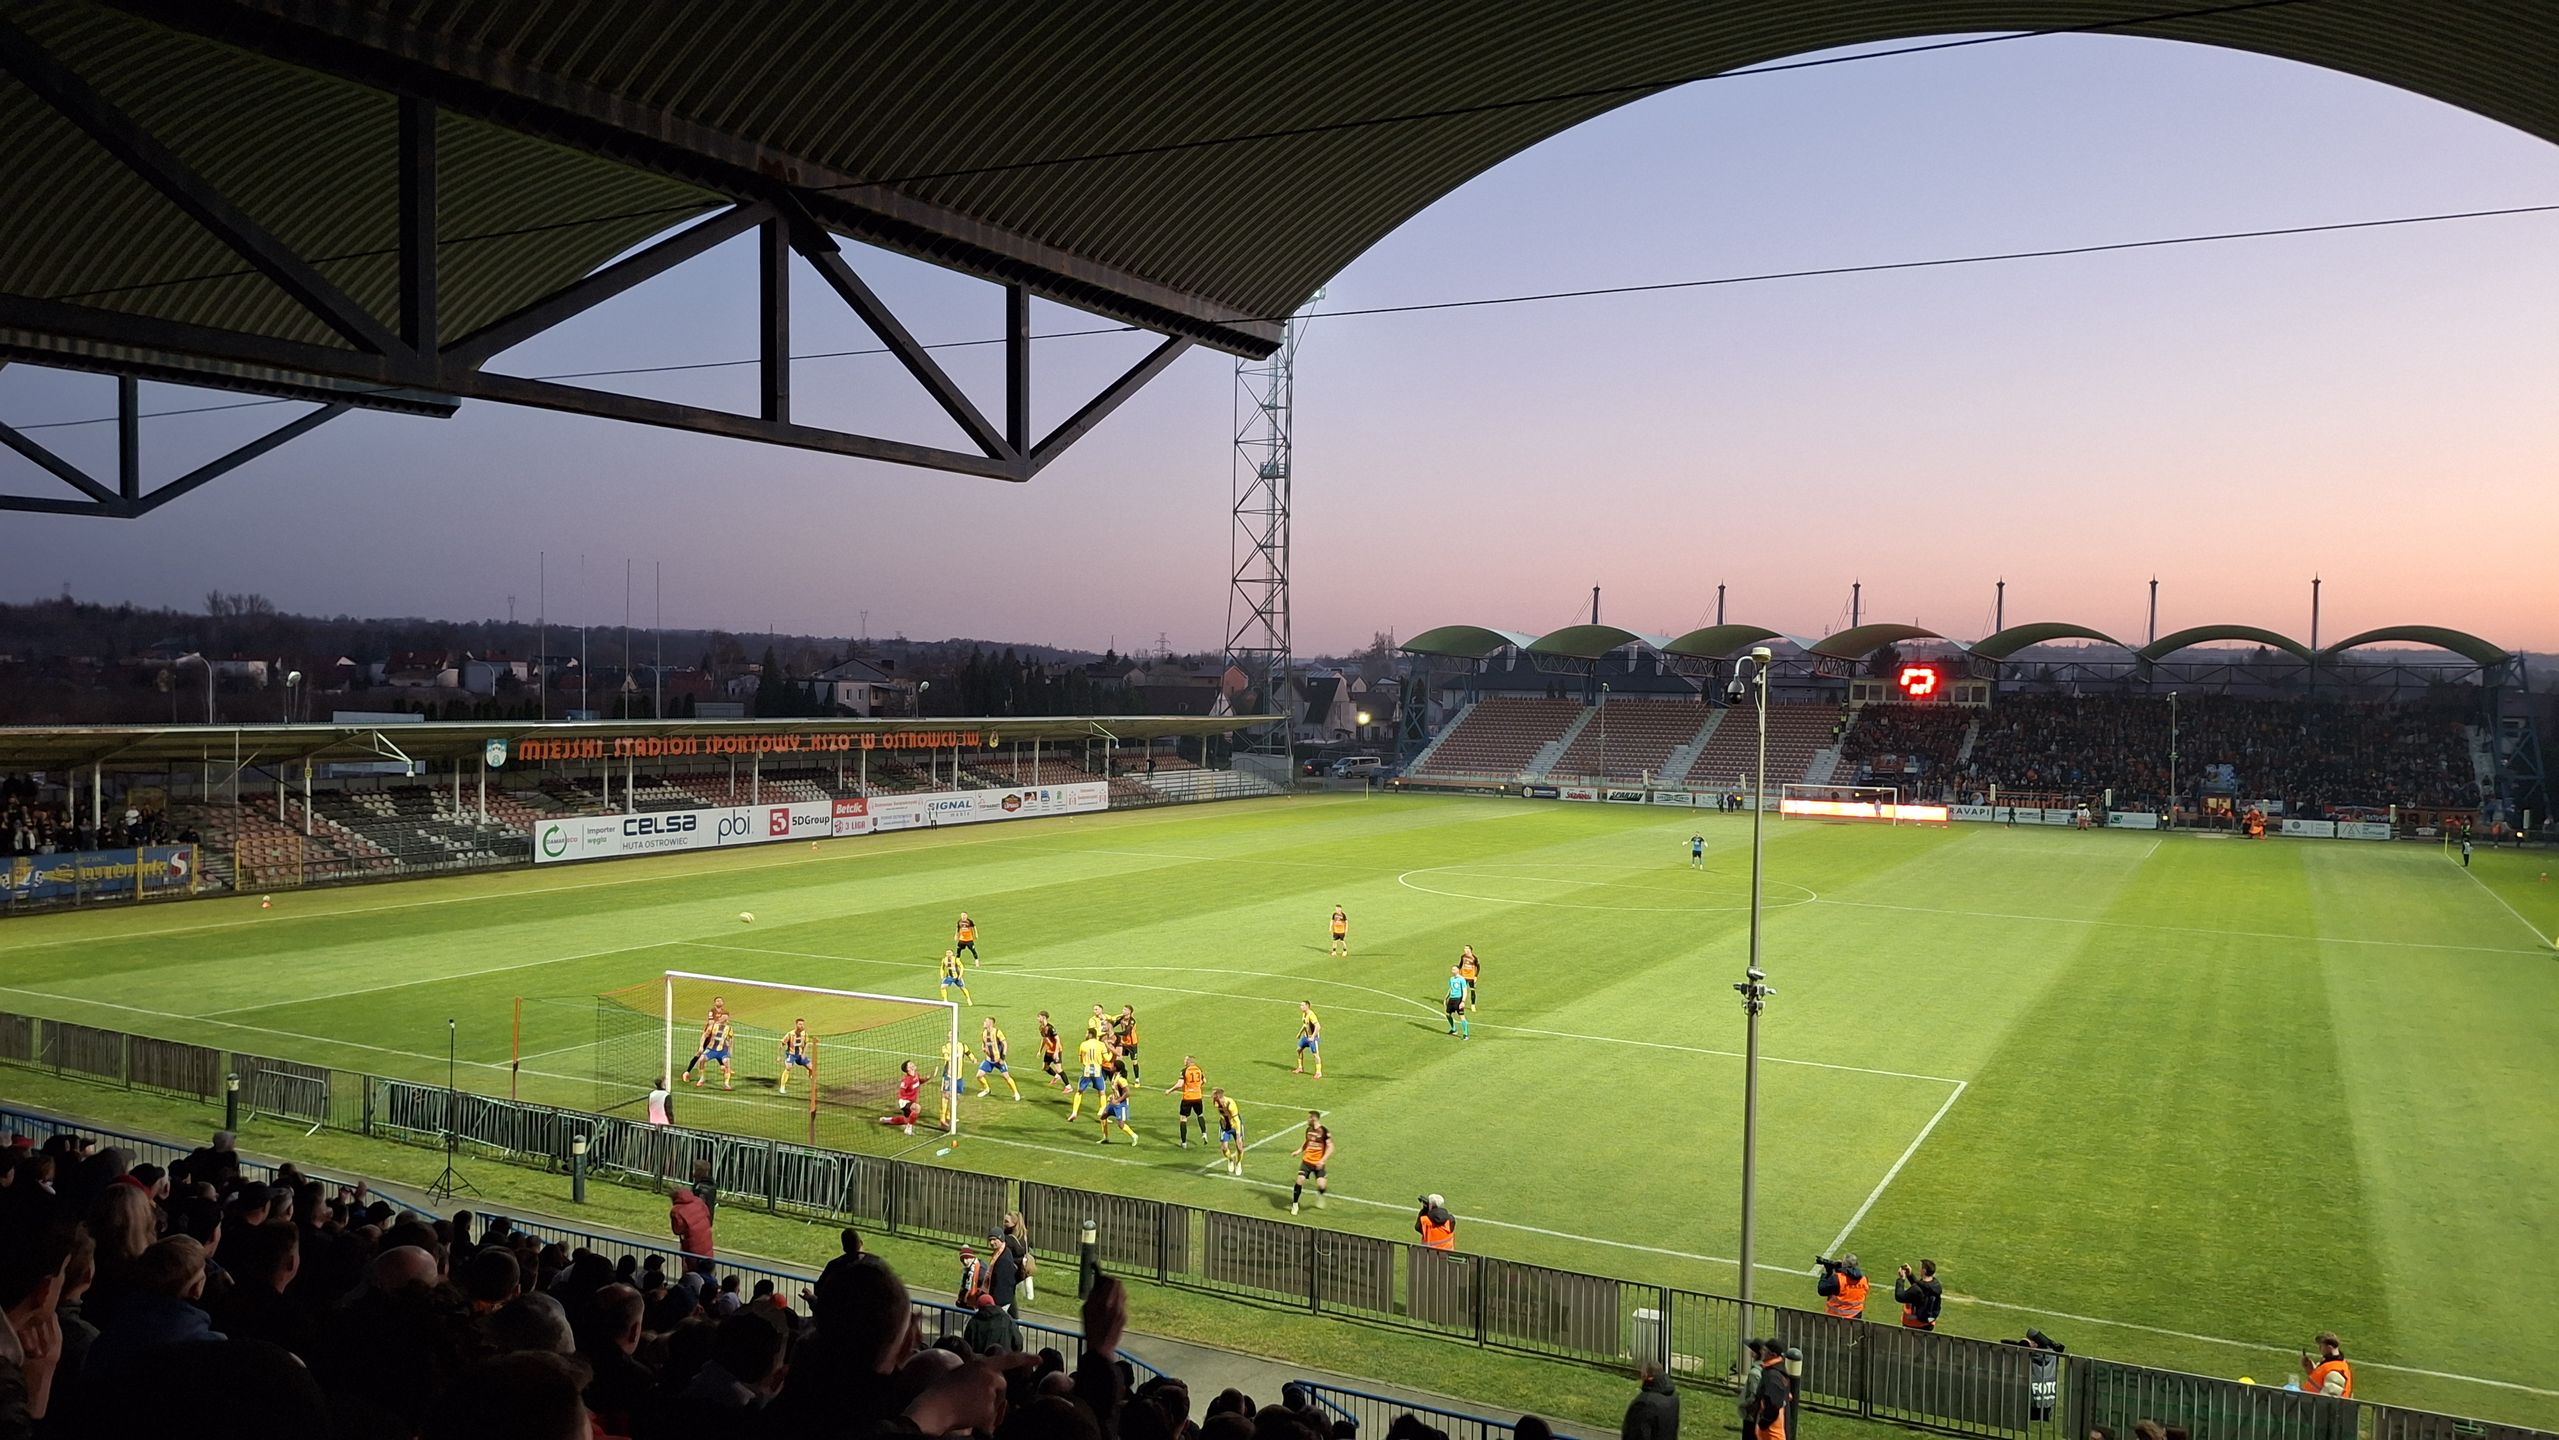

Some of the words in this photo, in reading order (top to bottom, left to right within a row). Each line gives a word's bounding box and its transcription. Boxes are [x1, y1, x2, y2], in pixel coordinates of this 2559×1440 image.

[519, 738, 602, 760] MIEJSKI
[614, 736, 697, 757] STADION
[706, 734, 800, 753] SPORTOWY
[861, 733, 875, 750] W
[883, 731, 957, 749] OSTROWCU
[836, 802, 863, 814] Betclic
[792, 815, 830, 826] 5DGroup
[851, 821, 866, 830] LIGA
[587, 826, 616, 836] Importer
[622, 840, 644, 850] HUTA
[645, 837, 688, 849] OSTROWIEC
[1090, 1048, 1095, 1061] 11
[1189, 1072, 1201, 1083] 13
